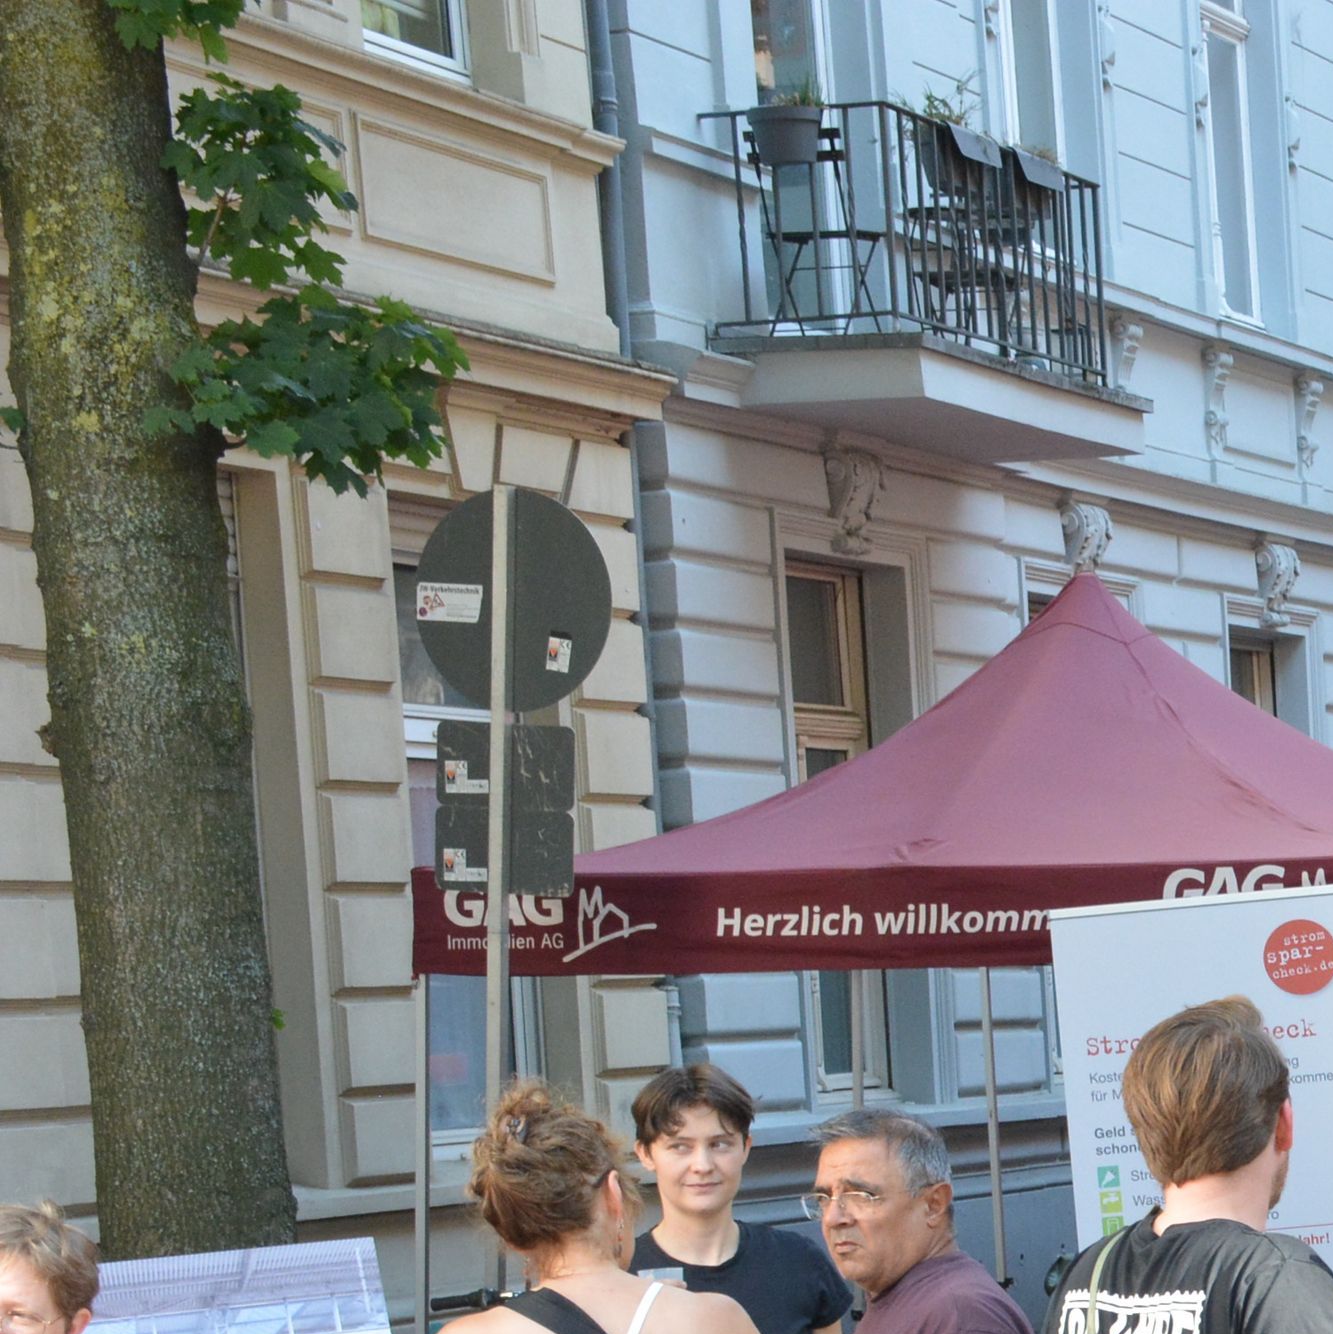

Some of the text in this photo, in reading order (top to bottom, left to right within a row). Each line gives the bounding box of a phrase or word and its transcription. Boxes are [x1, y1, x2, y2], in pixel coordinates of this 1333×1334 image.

[716, 903, 1052, 937] Herzlich willkomm
[541, 933, 565, 949] AG
[1283, 931, 1326, 946] strom
[1267, 946, 1325, 965] spar-
[1091, 1089, 1108, 1102] für
[1094, 1126, 1126, 1140] Geld
